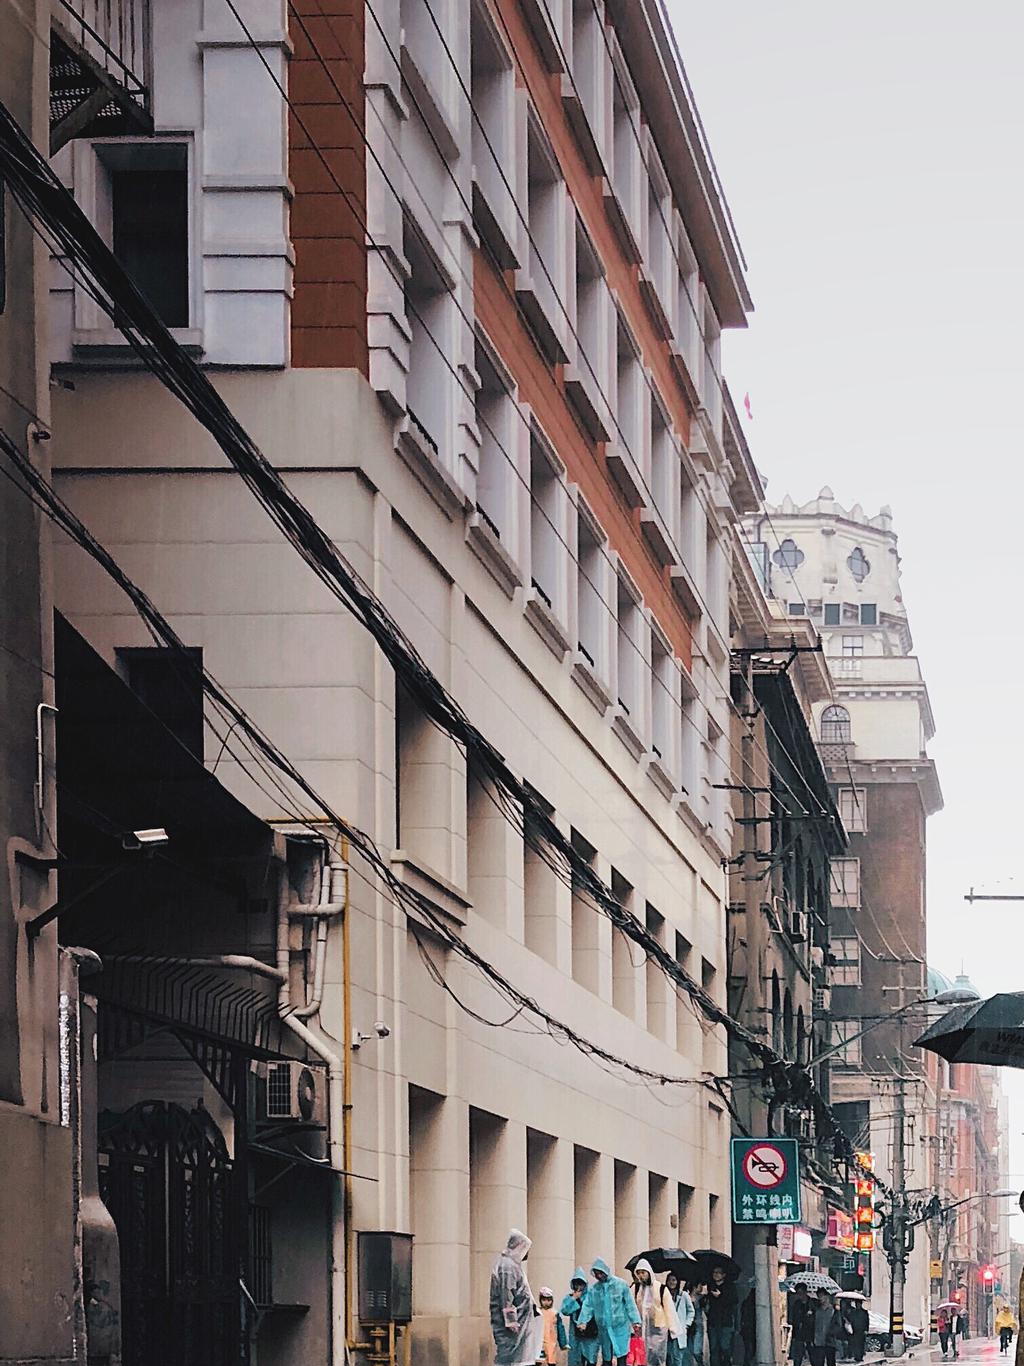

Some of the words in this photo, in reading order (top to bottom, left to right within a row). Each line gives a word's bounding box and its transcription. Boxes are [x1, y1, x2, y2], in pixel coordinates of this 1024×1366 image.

[742, 1194, 793, 1206] 外环线内
[742, 1207, 794, 1220] 禁鸣喇叭
